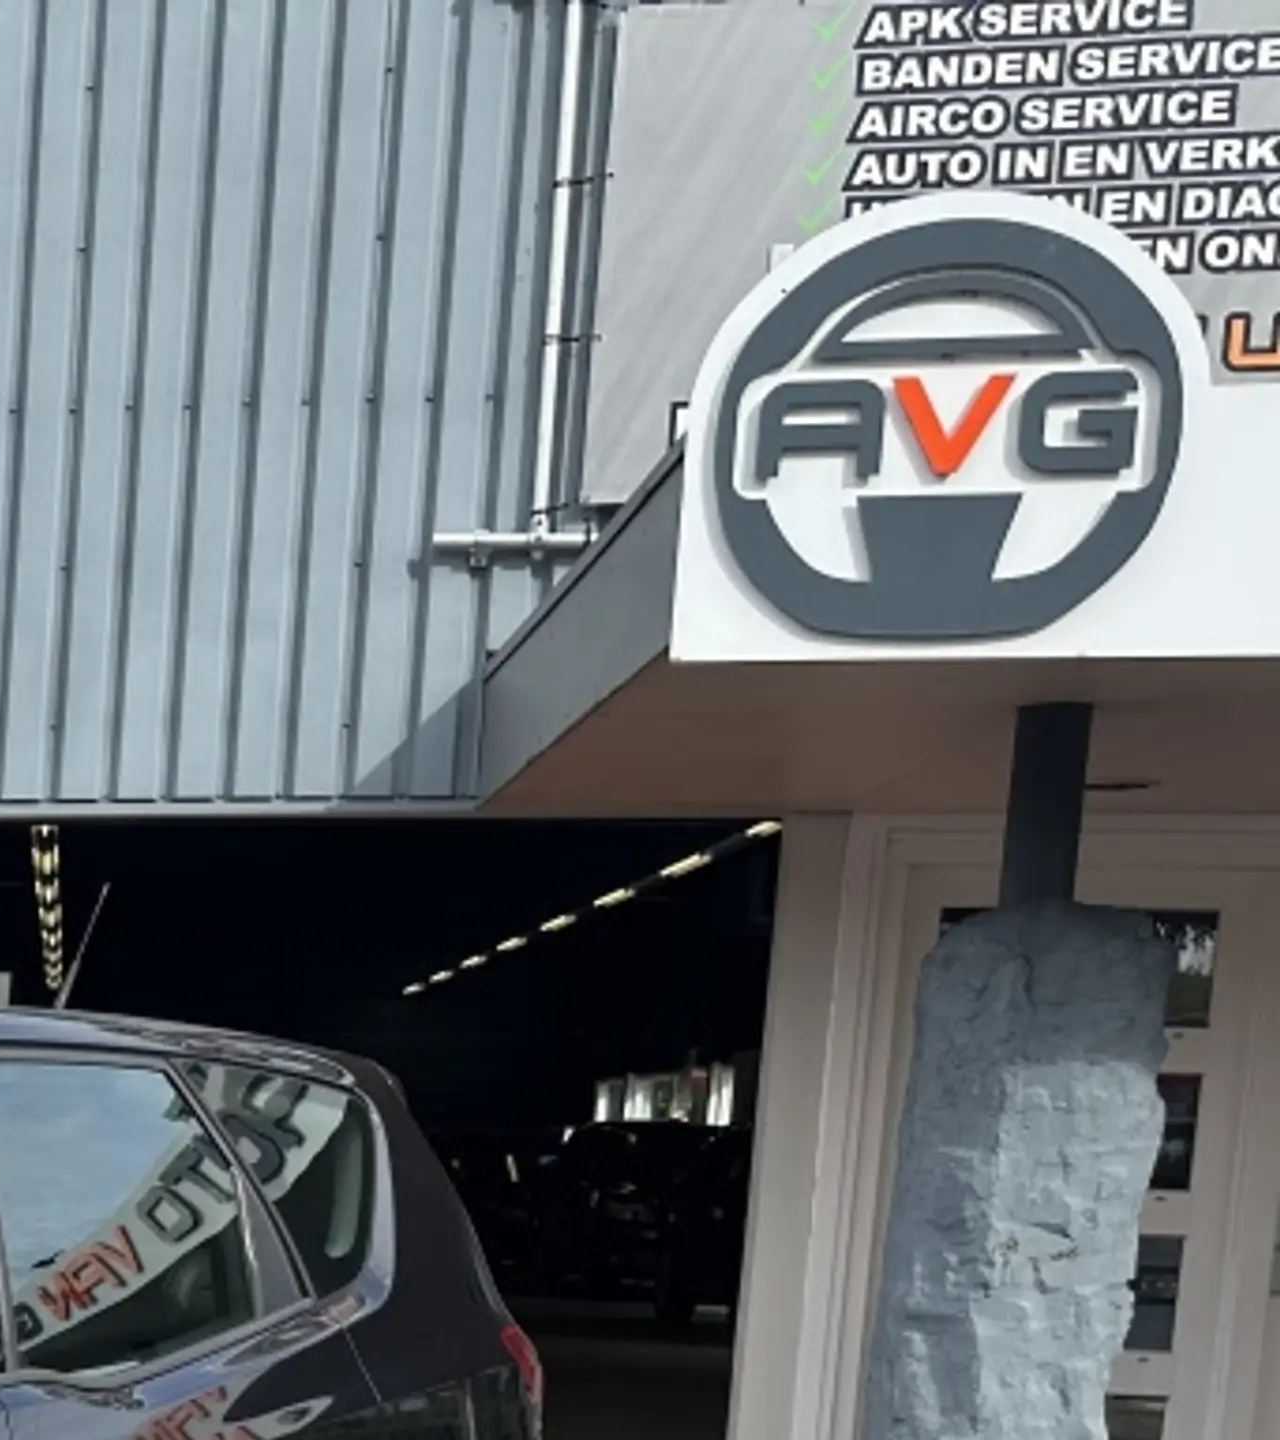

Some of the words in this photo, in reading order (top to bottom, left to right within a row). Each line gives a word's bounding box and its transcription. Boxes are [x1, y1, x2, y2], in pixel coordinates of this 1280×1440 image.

[862, 7, 963, 43] APK
[977, 0, 1188, 36] SERVICE
[862, 51, 1060, 91] BANDEN
[1074, 37, 1280, 80] SERVICE
[855, 100, 1005, 138] AIRCO
[1019, 90, 1232, 131] SERVICE
[851, 150, 982, 186] AUTO
[997, 147, 1049, 180] IN
[1063, 142, 1130, 178] EN
[1101, 190, 1166, 223] EN
[753, 368, 1140, 484] AVG
